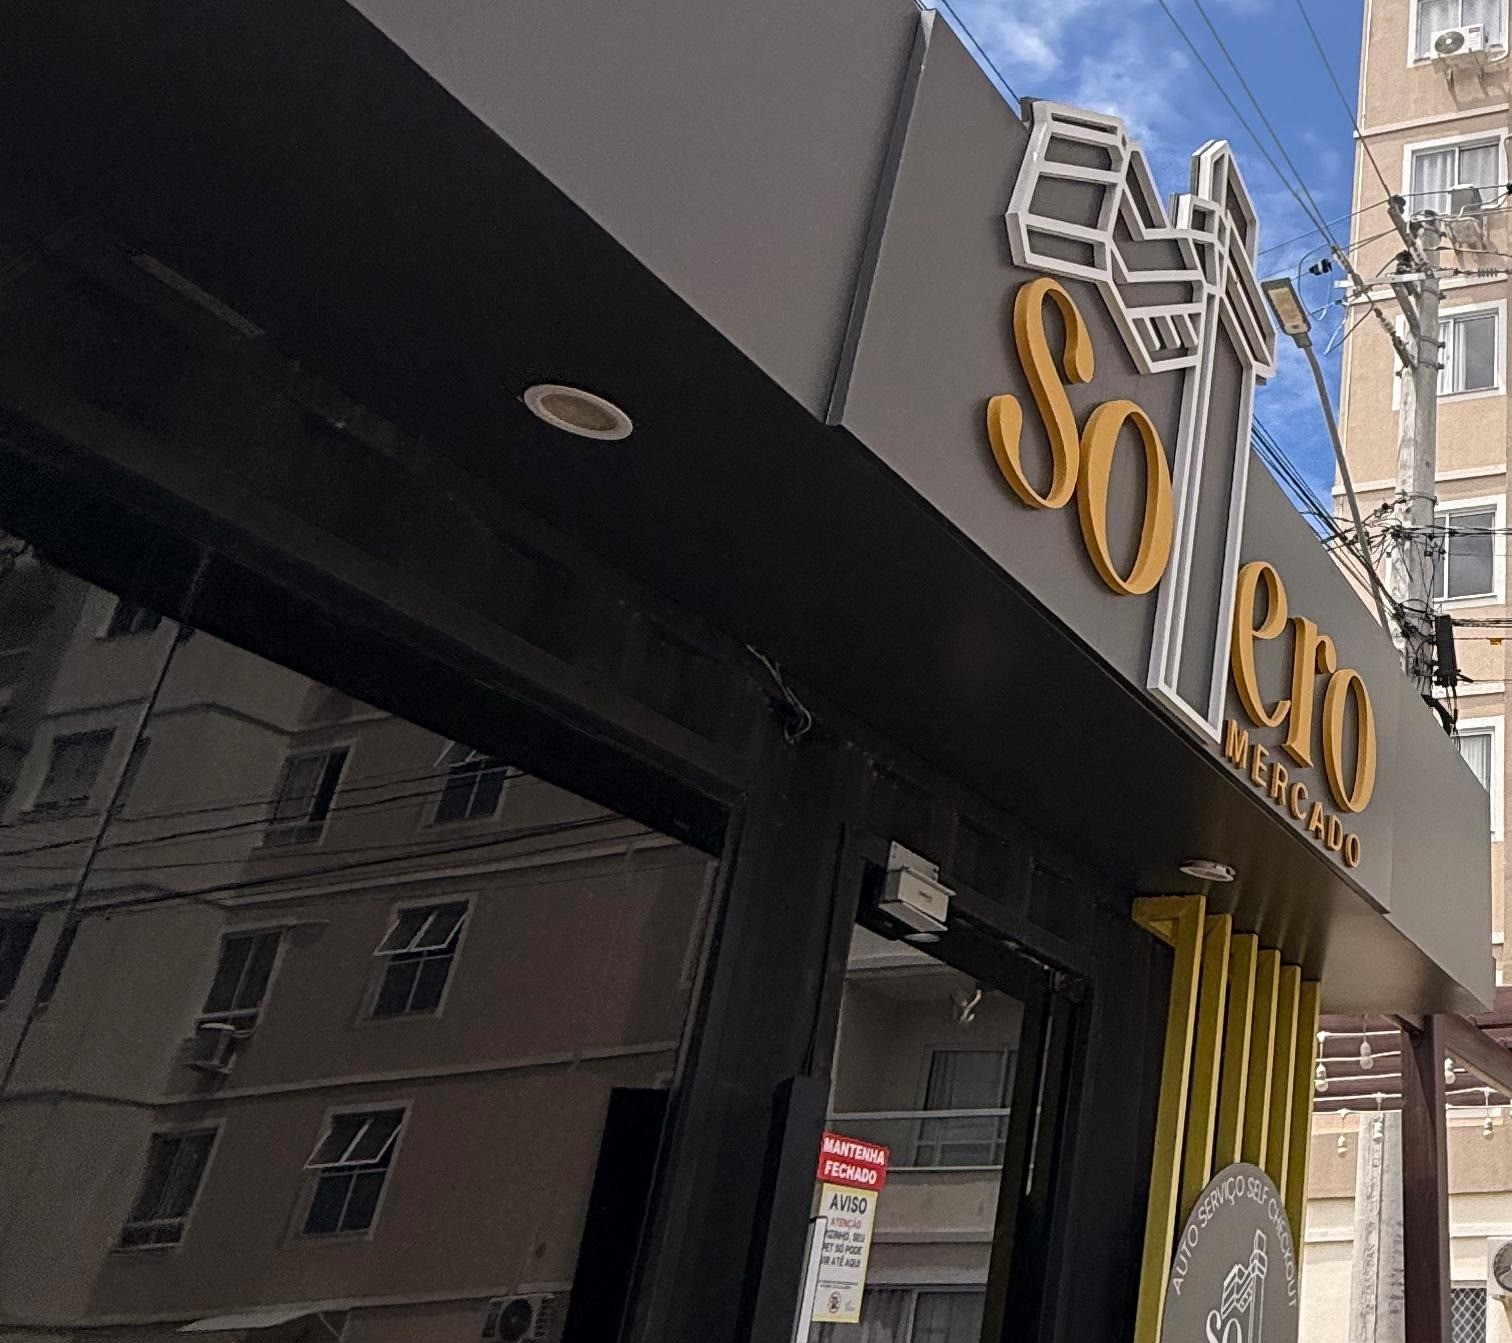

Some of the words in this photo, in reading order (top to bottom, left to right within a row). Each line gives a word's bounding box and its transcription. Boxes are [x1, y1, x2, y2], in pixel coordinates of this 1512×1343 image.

[1225, 719, 1361, 869] MERCADO
[823, 1137, 885, 1165] MANTENHA
[824, 1160, 877, 1185] FECHADO
[829, 1193, 868, 1214] AVISO
[1173, 1224, 1199, 1296] AUTO
[1198, 1175, 1245, 1228] SERVIÇO
[1246, 1177, 1270, 1205] SELF
[1267, 1198, 1297, 1307] CHECKOUT
